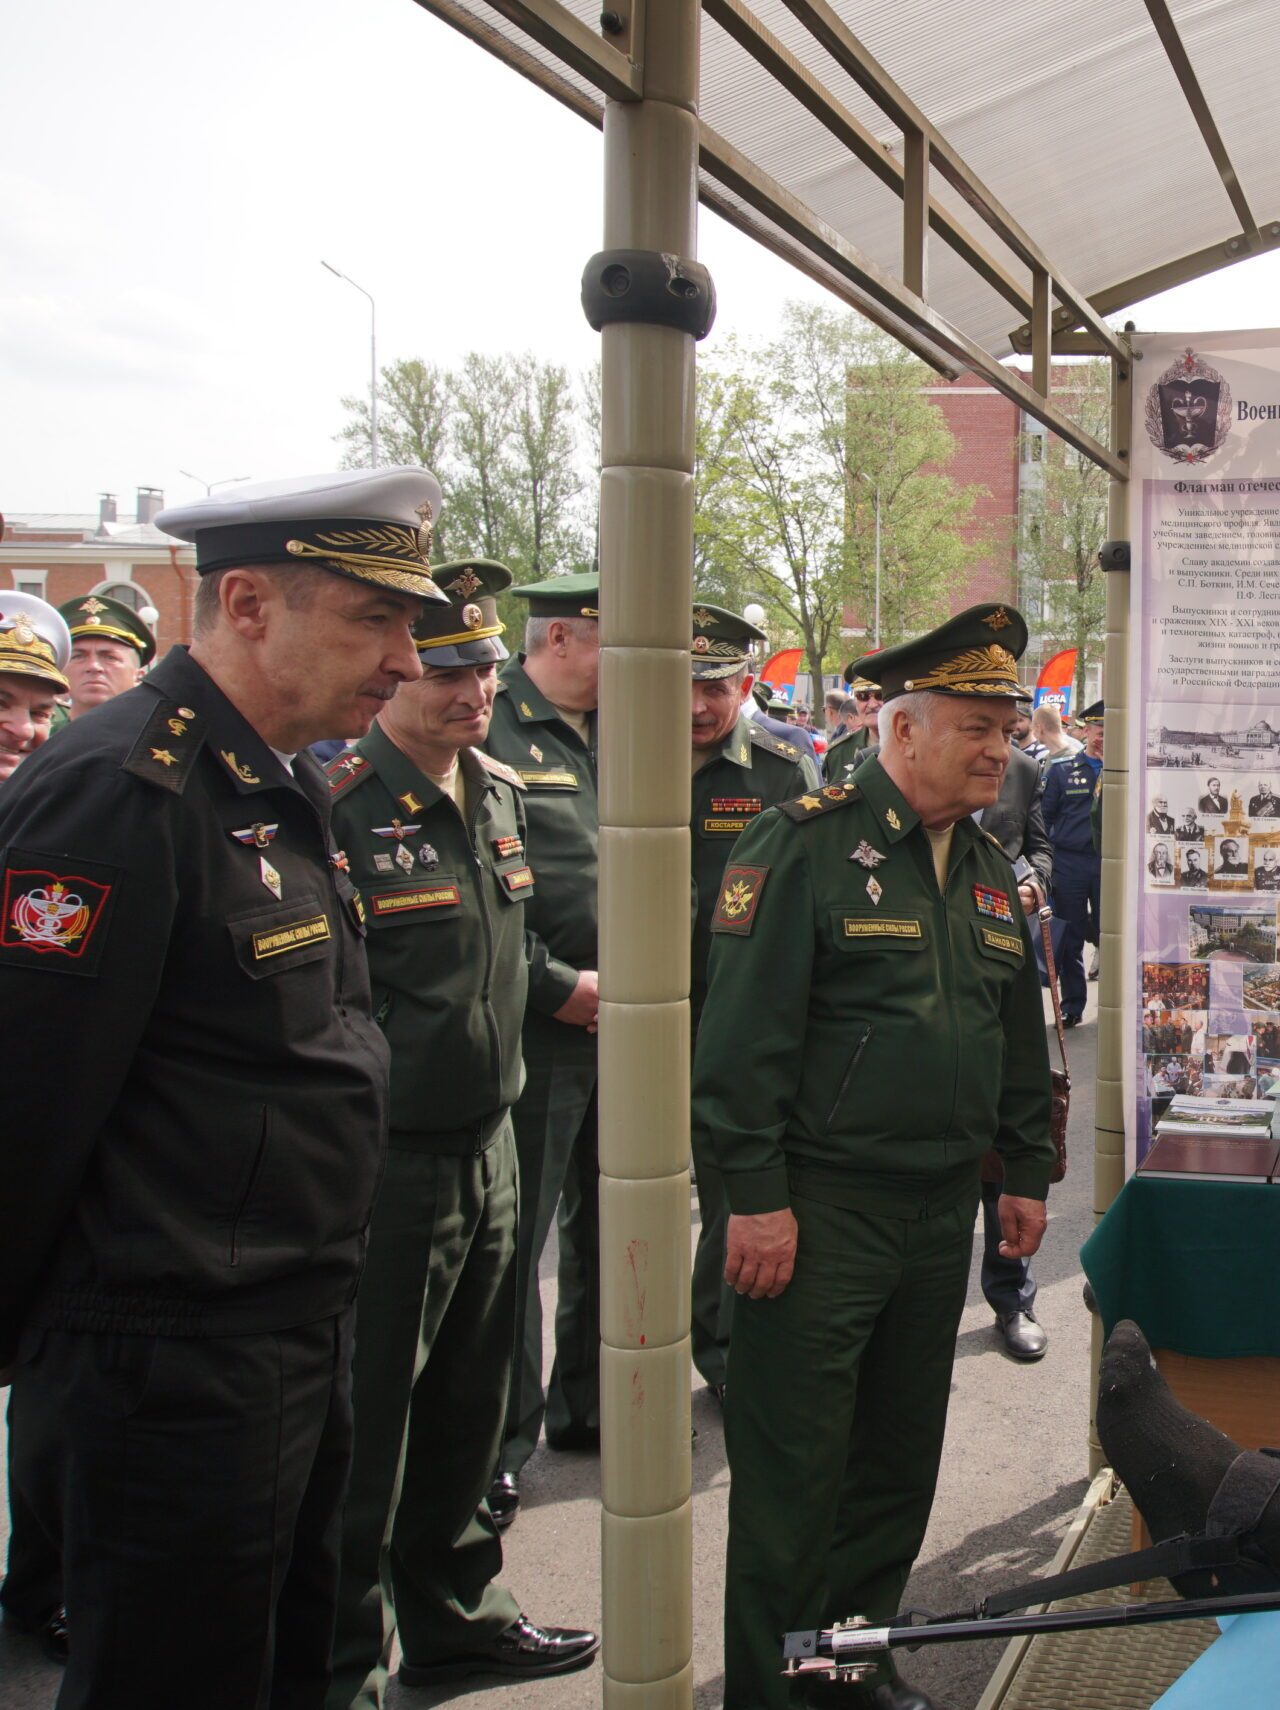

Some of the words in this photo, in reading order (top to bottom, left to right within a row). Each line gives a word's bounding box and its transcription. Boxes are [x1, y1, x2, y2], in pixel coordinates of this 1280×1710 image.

[1173, 479, 1234, 495] Флагман
[1157, 543, 1215, 551] учреждением
[1218, 540, 1272, 551] медицинской
[1176, 570, 1231, 578] выпускники.
[1234, 568, 1260, 578] Среди
[1178, 579, 1197, 587] С.П.
[1199, 579, 1233, 589] Боткин,
[1236, 579, 1256, 587] И.М.
[1236, 590, 1256, 598] П.Ф.
[1168, 655, 1203, 665] Заслуги
[1205, 658, 1263, 667] выпускников
[1040, 694, 1066, 704] ЦСКА
[848, 923, 885, 933] ВООРУЖЕННЫЕ
[886, 923, 900, 933] СИЛЫ
[900, 924, 917, 933] РОССИИ
